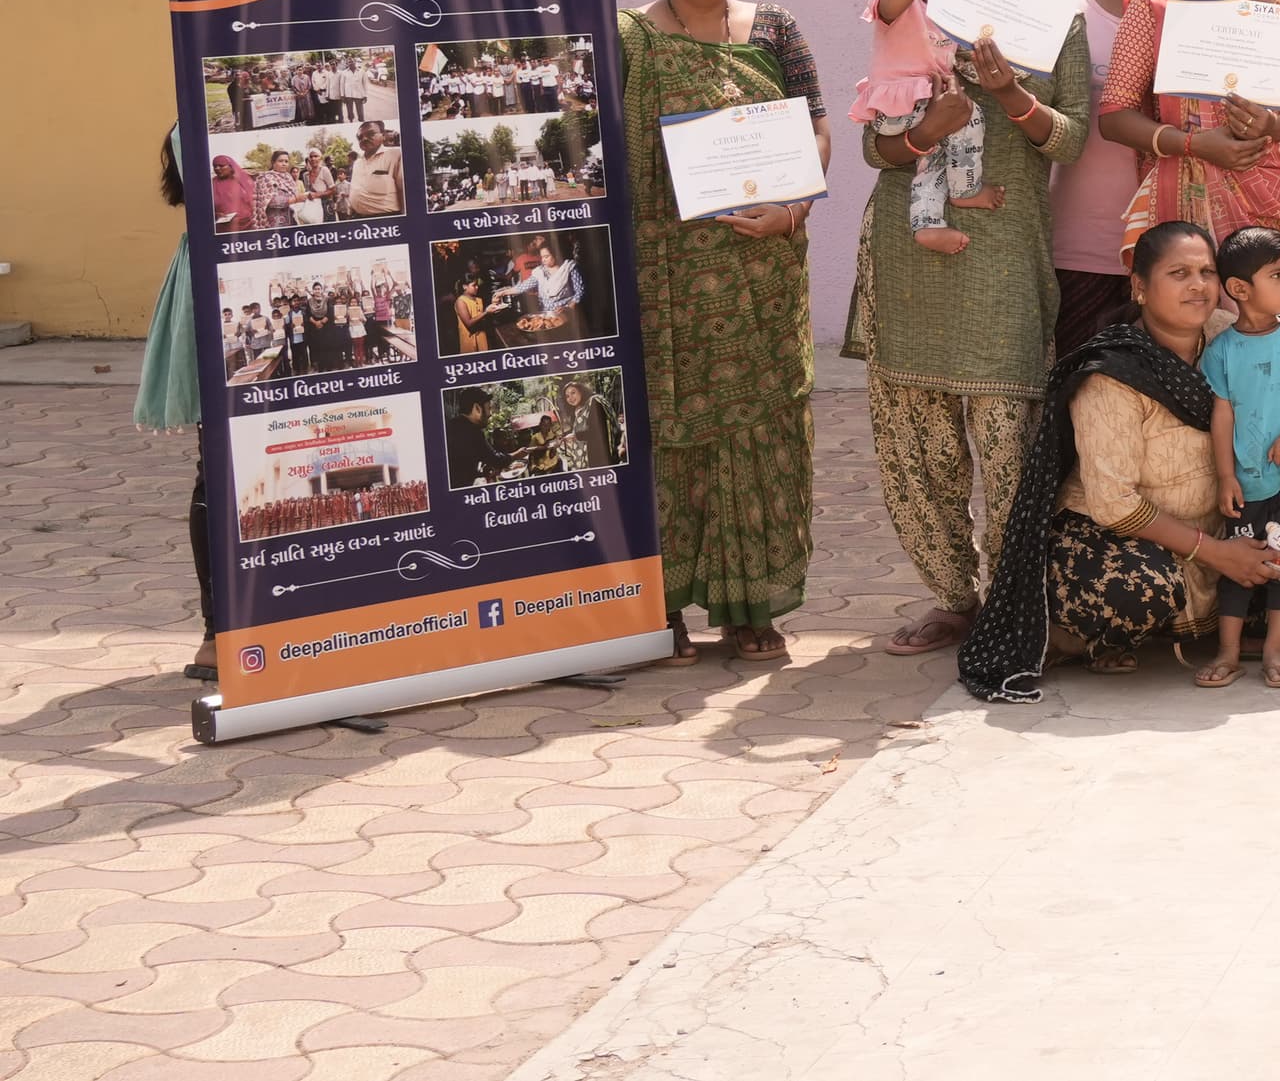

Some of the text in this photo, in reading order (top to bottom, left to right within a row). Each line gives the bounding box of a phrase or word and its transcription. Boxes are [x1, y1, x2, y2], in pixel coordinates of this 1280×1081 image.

[524, 207, 542, 224] ની
[293, 379, 345, 399] વિતરણ
[531, 503, 548, 520] ની
[513, 582, 642, 618] Deepali Inamdar
[279, 610, 468, 661] deepaliinamdarofficial
